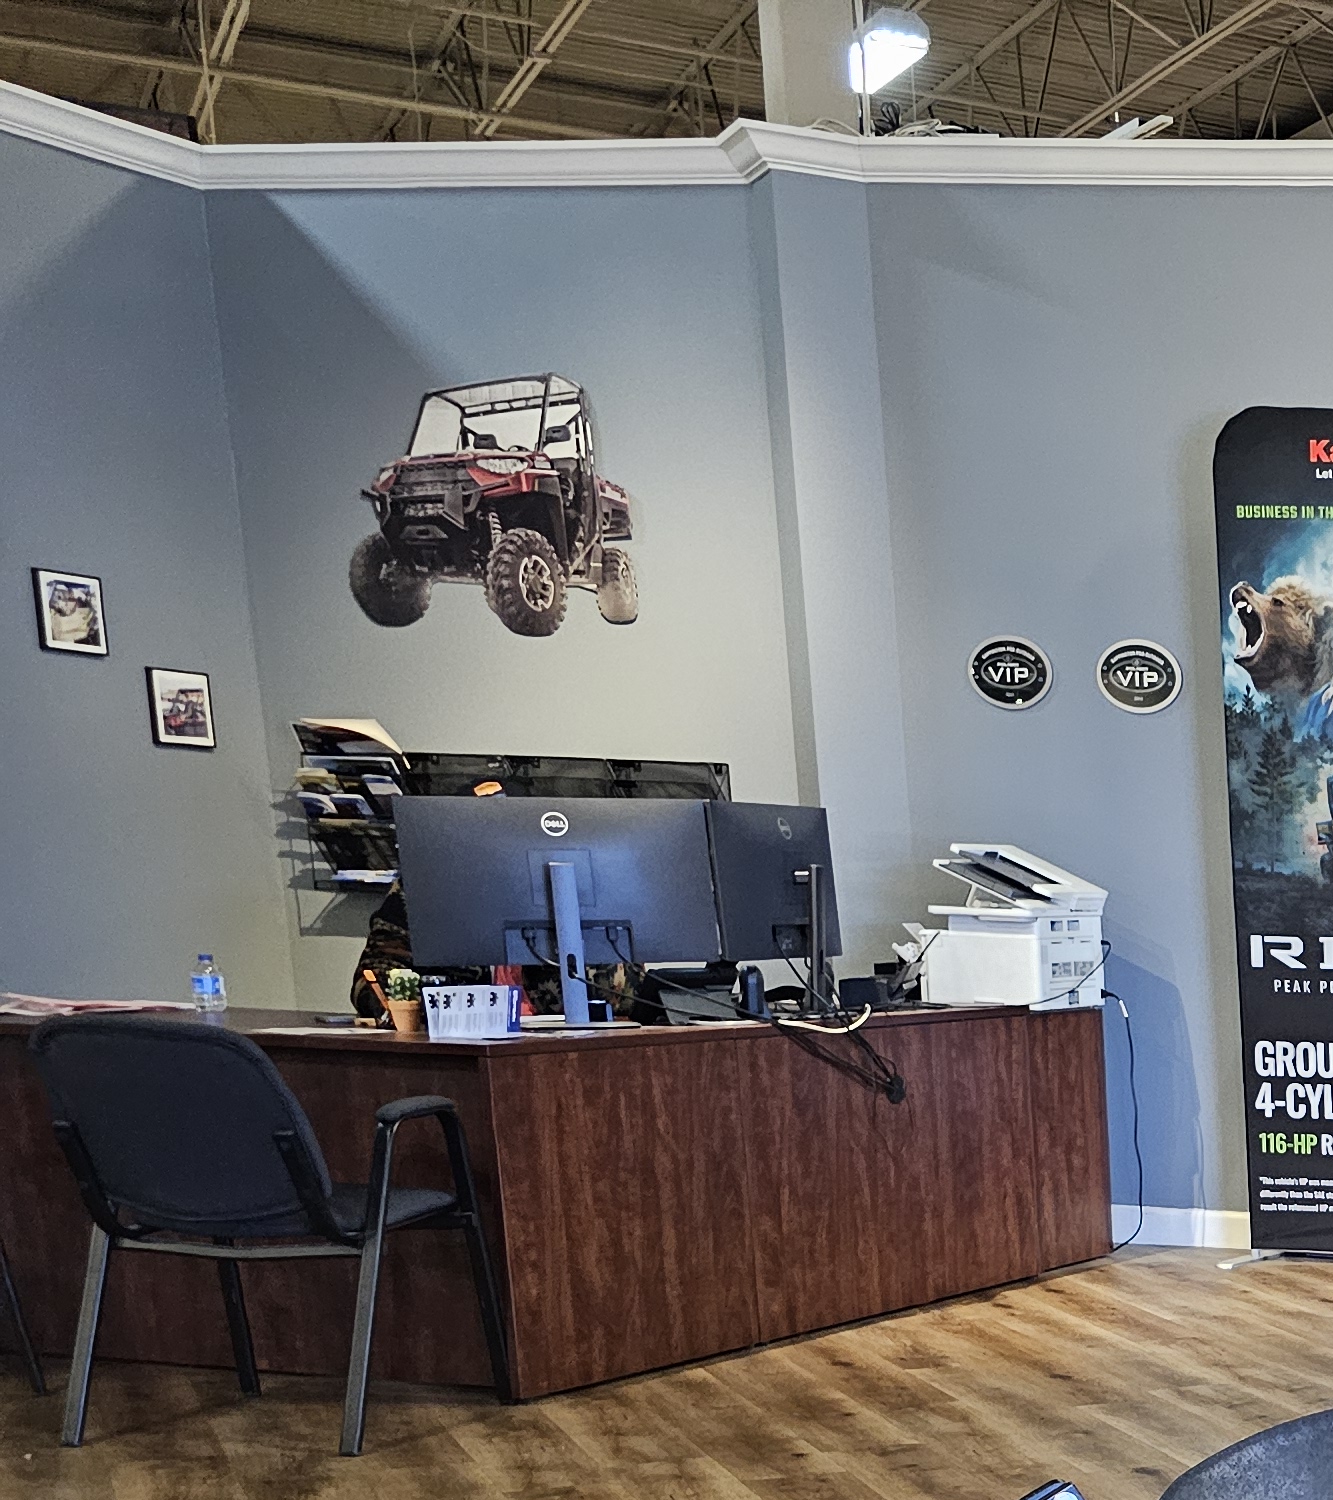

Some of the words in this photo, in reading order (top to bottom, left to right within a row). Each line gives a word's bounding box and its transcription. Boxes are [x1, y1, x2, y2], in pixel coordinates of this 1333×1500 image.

[1316, 468, 1333, 479] Let
[1236, 504, 1298, 519] BUSINESS
[1302, 505, 1315, 519] IN
[986, 666, 1030, 684] VIP
[1116, 670, 1159, 688] VIP
[544, 818, 566, 829] DELL
[1273, 979, 1312, 994] PEAK
[1259, 1132, 1318, 1156] 116-HP
